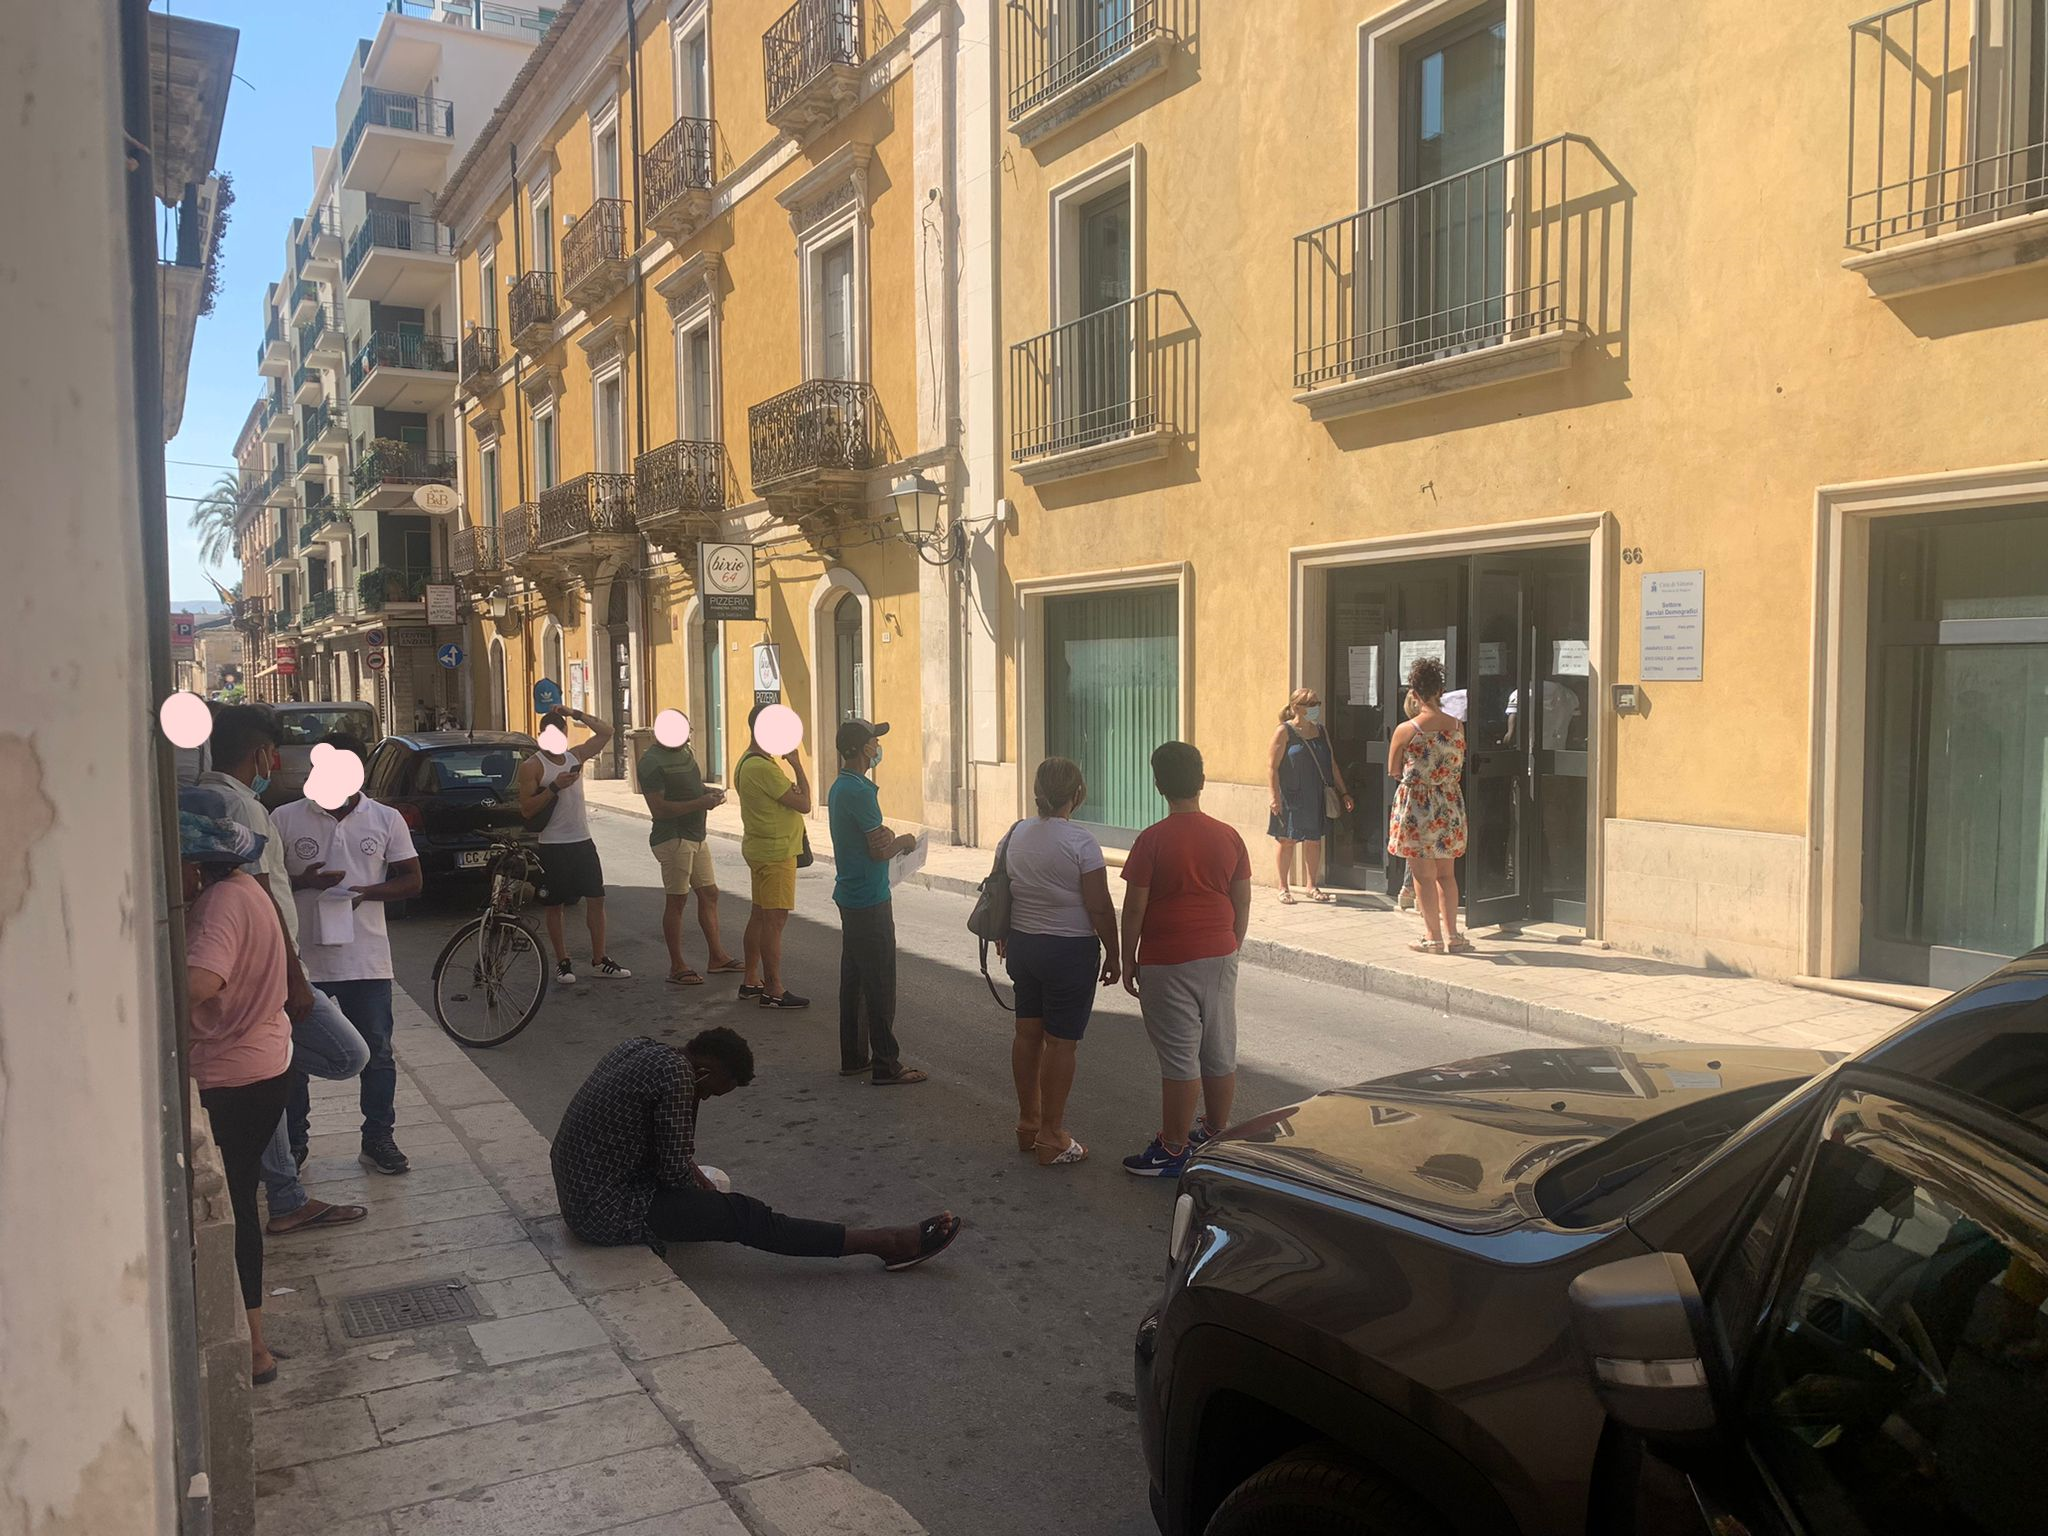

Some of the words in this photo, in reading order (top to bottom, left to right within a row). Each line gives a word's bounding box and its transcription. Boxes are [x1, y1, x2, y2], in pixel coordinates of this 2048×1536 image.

[426, 493, 448, 505] B&B
[1622, 547, 1643, 564] 66
[711, 556, 744, 571] bixio
[721, 572, 737, 583] 64
[709, 596, 750, 606] PIZZERIA
